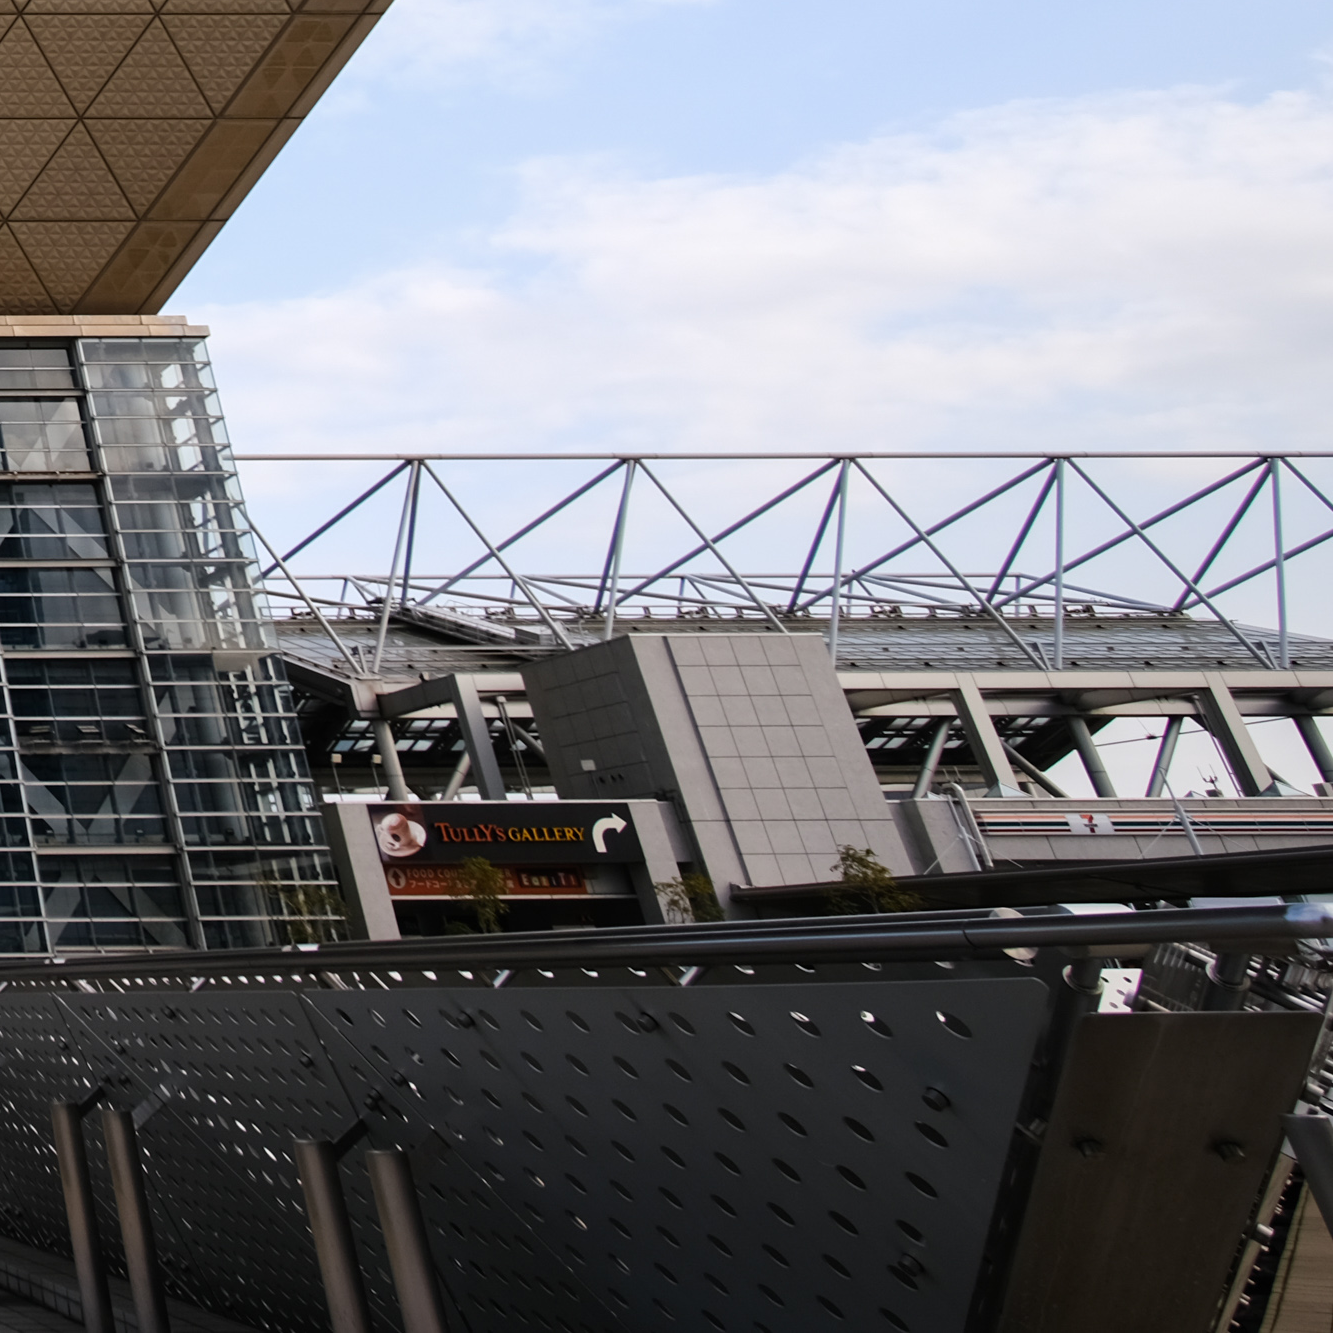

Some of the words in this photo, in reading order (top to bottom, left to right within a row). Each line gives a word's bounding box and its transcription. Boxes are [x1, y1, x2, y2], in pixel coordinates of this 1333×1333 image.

[435, 822, 507, 842] TULLY'S
[508, 827, 584, 842] GALLERY
[406, 868, 436, 878] FOOD
